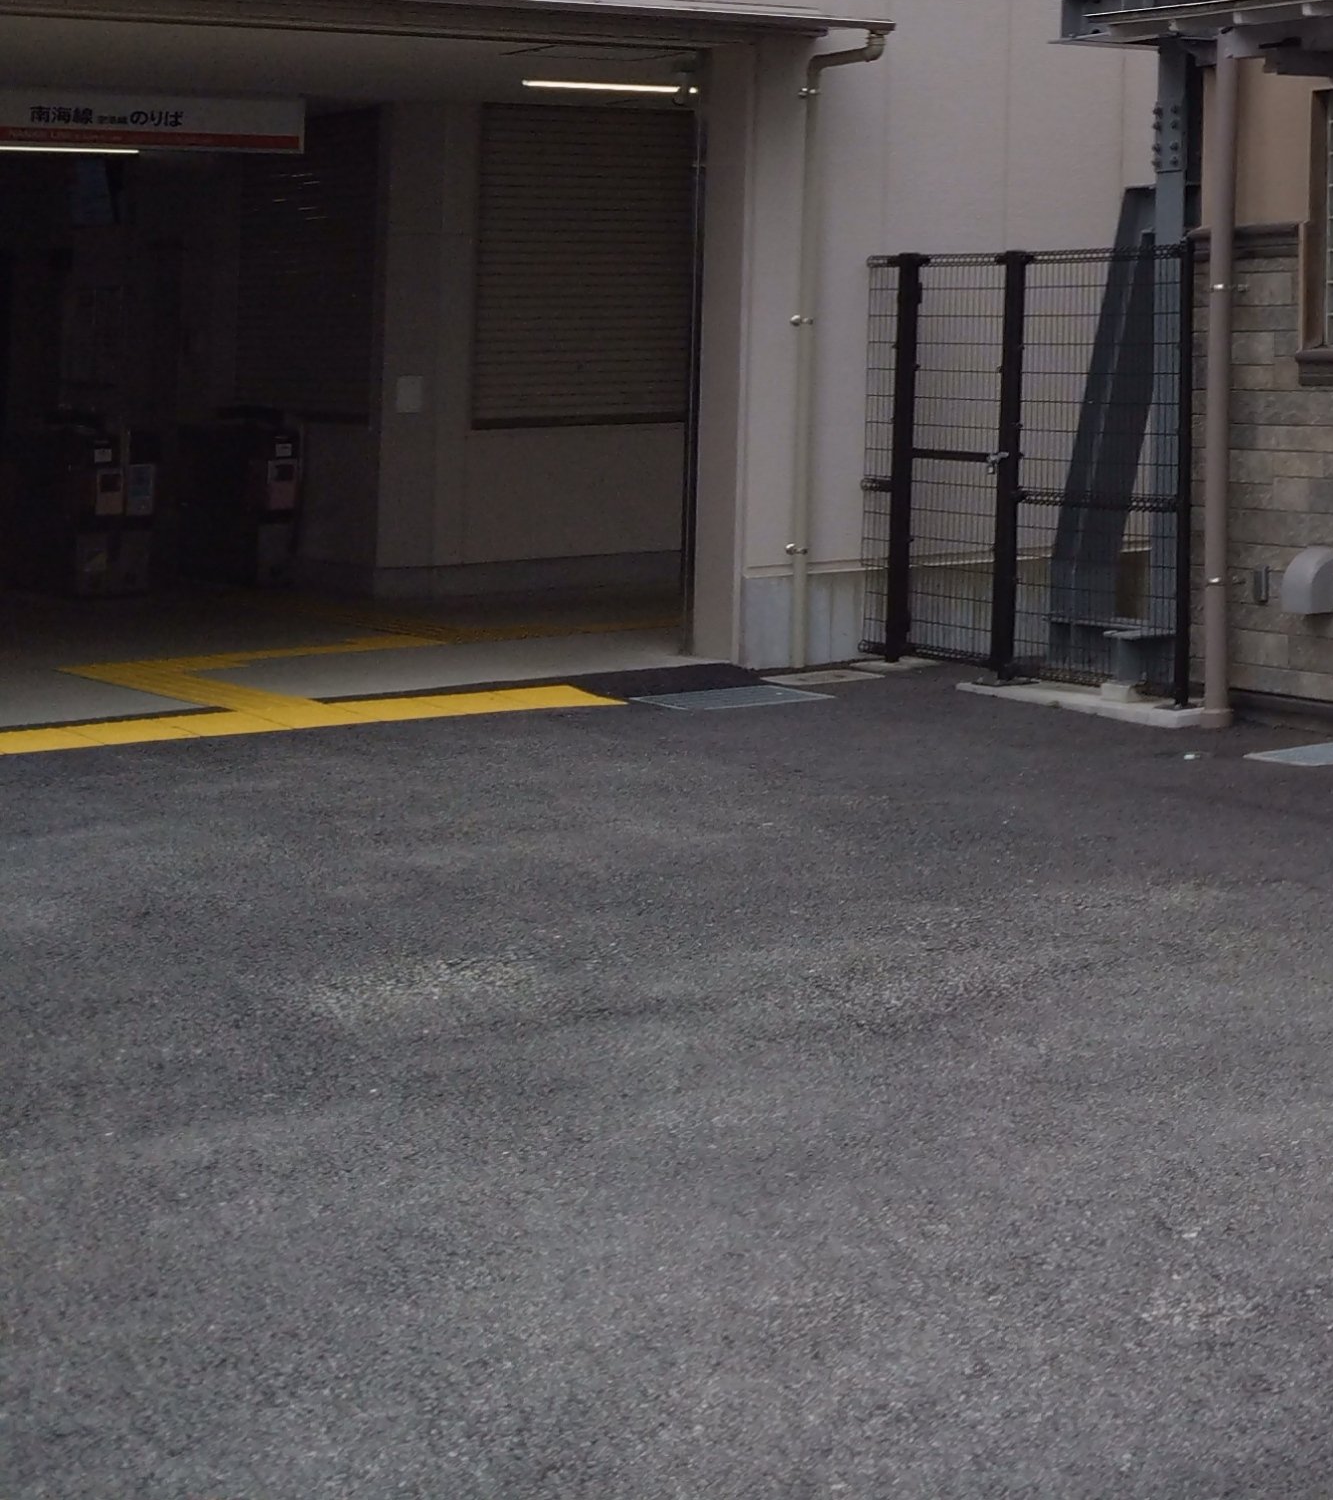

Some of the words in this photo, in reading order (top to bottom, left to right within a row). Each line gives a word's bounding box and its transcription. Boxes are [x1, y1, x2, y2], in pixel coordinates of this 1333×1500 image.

[30, 106, 93, 125] 南海線
[130, 110, 184, 127] のりば
